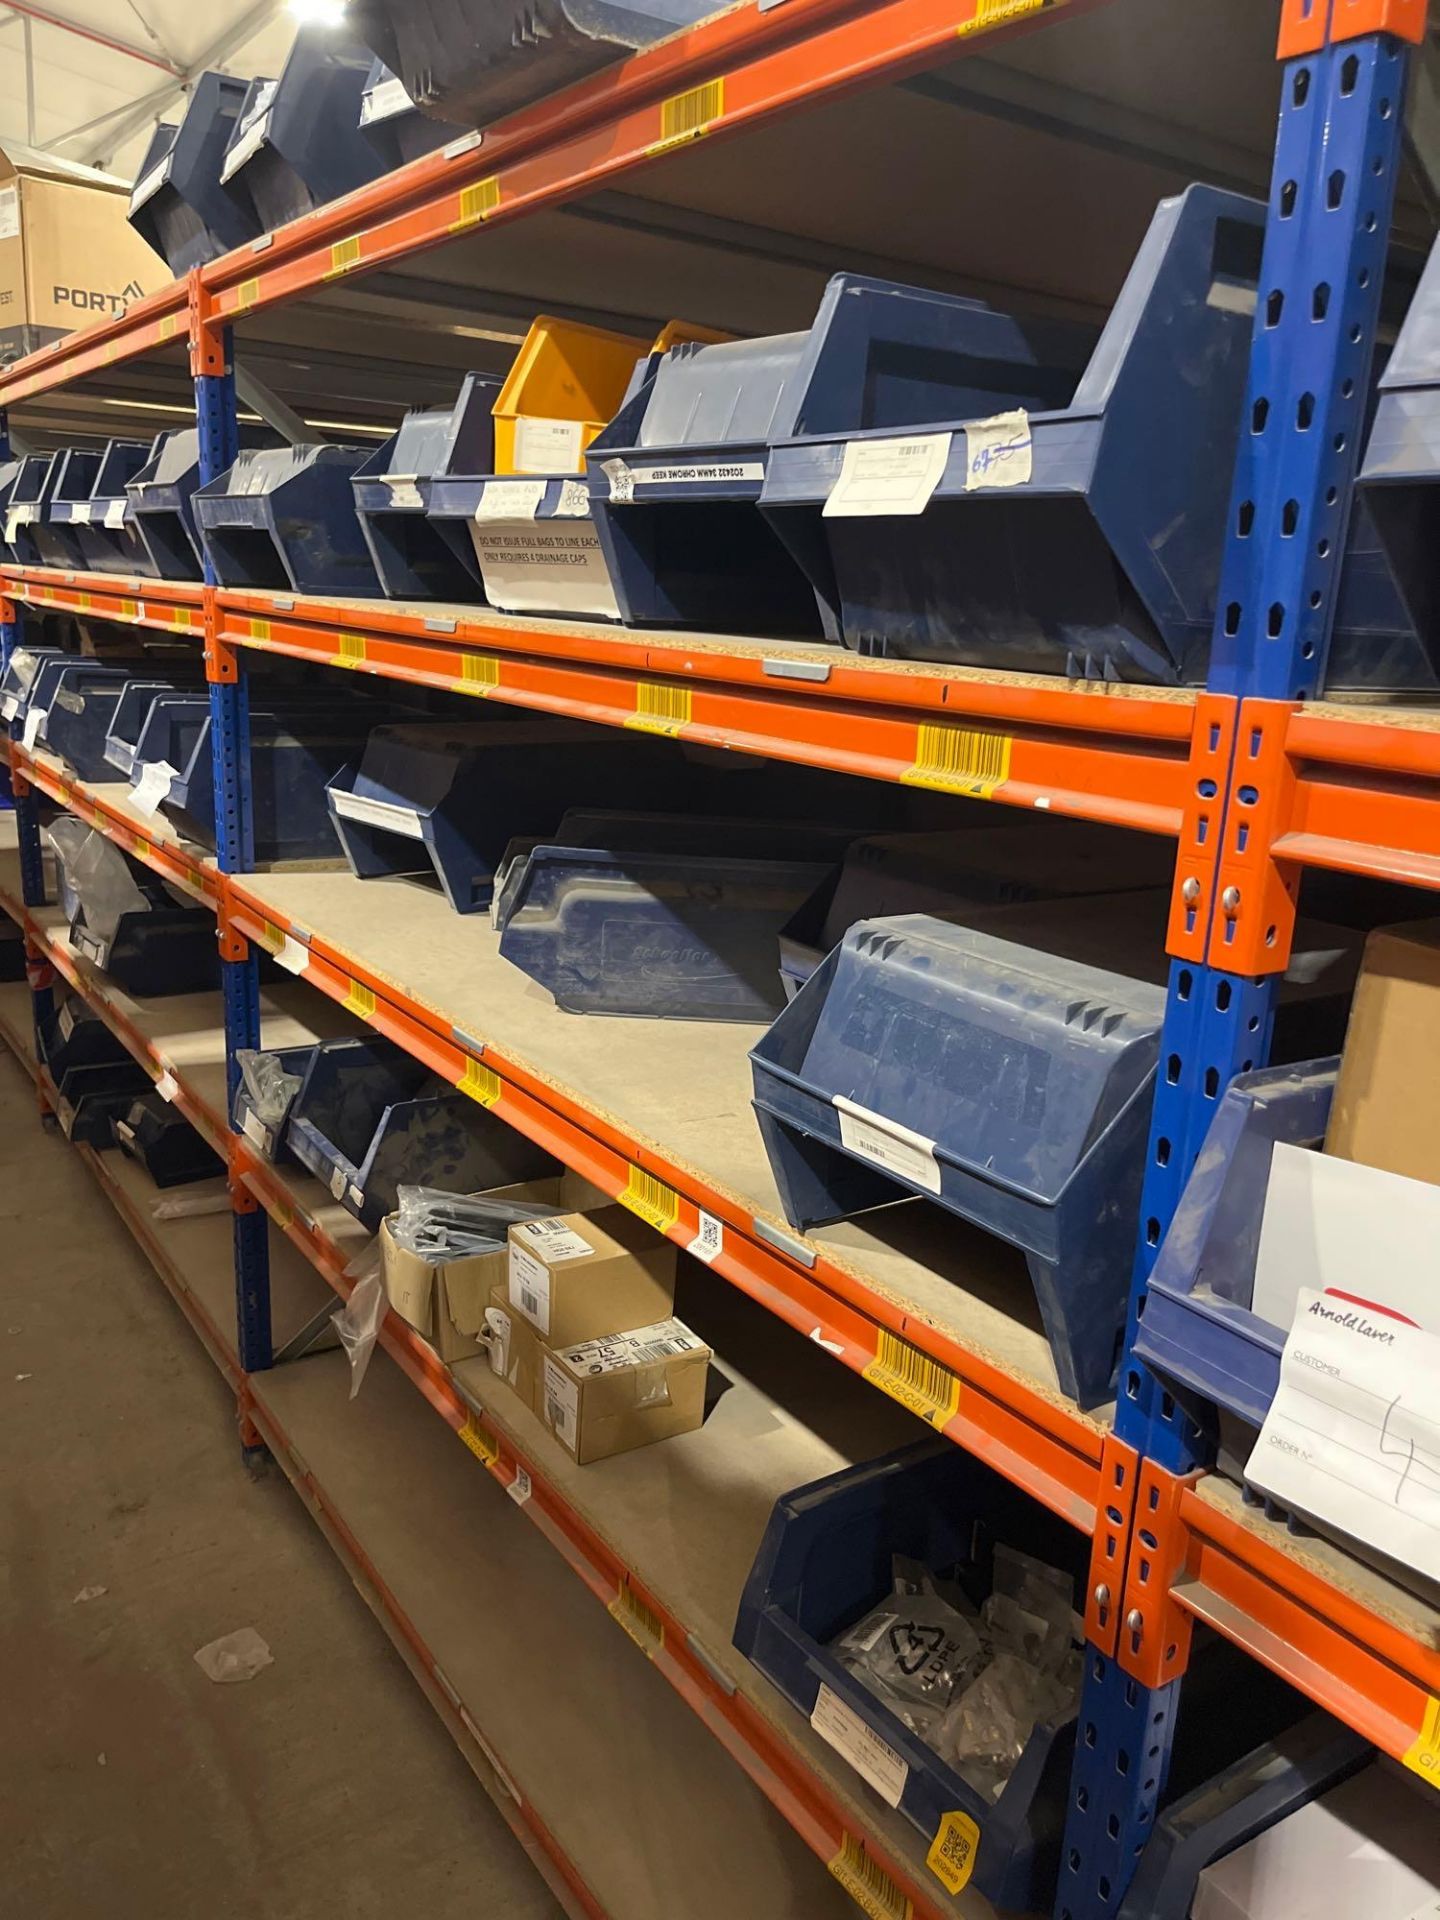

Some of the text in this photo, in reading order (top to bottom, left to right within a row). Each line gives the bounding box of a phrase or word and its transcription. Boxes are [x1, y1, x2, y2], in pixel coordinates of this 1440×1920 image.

[651, 470, 667, 480] KEEP
[667, 469, 696, 479] CHROME
[698, 468, 717, 478] 34MM
[480, 536, 600, 548] DO NOT ISSUE FULL BAGS TO LINE EACH
[484, 552, 500, 561] ONLY
[500, 552, 530, 562] REQUIRES
[535, 554, 569, 563] DRAINAGE
[570, 554, 588, 564] CAPS
[1308, 1301, 1396, 1346] Arnold Laver
[1292, 1350, 1341, 1377] CUSTOMER
[1270, 1435, 1299, 1456] ORDER
[922, 1640, 961, 1684] LDPE
